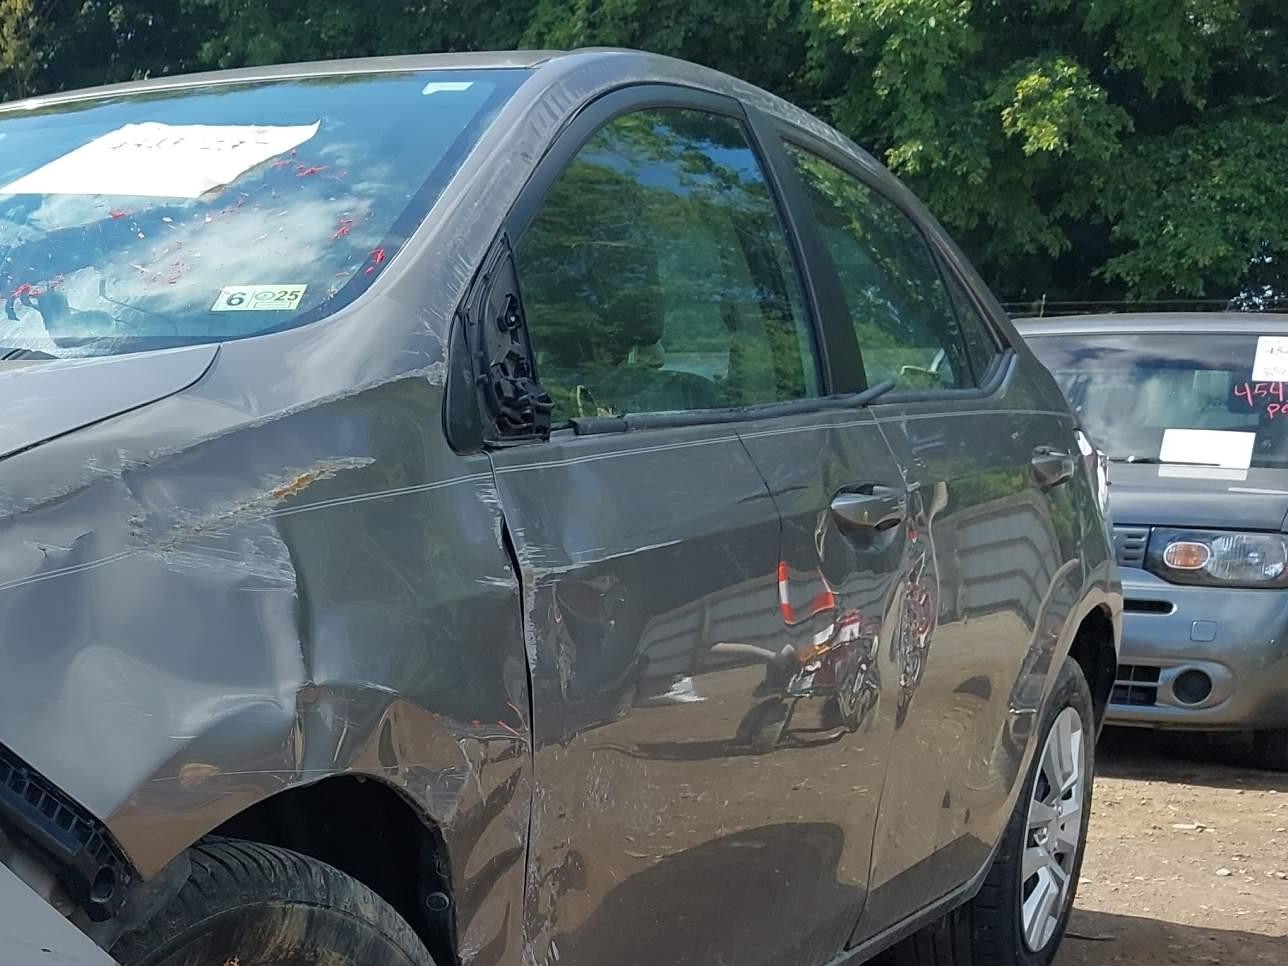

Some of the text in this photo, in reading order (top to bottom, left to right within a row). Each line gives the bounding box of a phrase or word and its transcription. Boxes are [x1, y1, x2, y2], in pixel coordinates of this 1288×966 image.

[226, 292, 247, 307] 6
[274, 290, 302, 302] 25
[1234, 382, 1288, 407] 454
